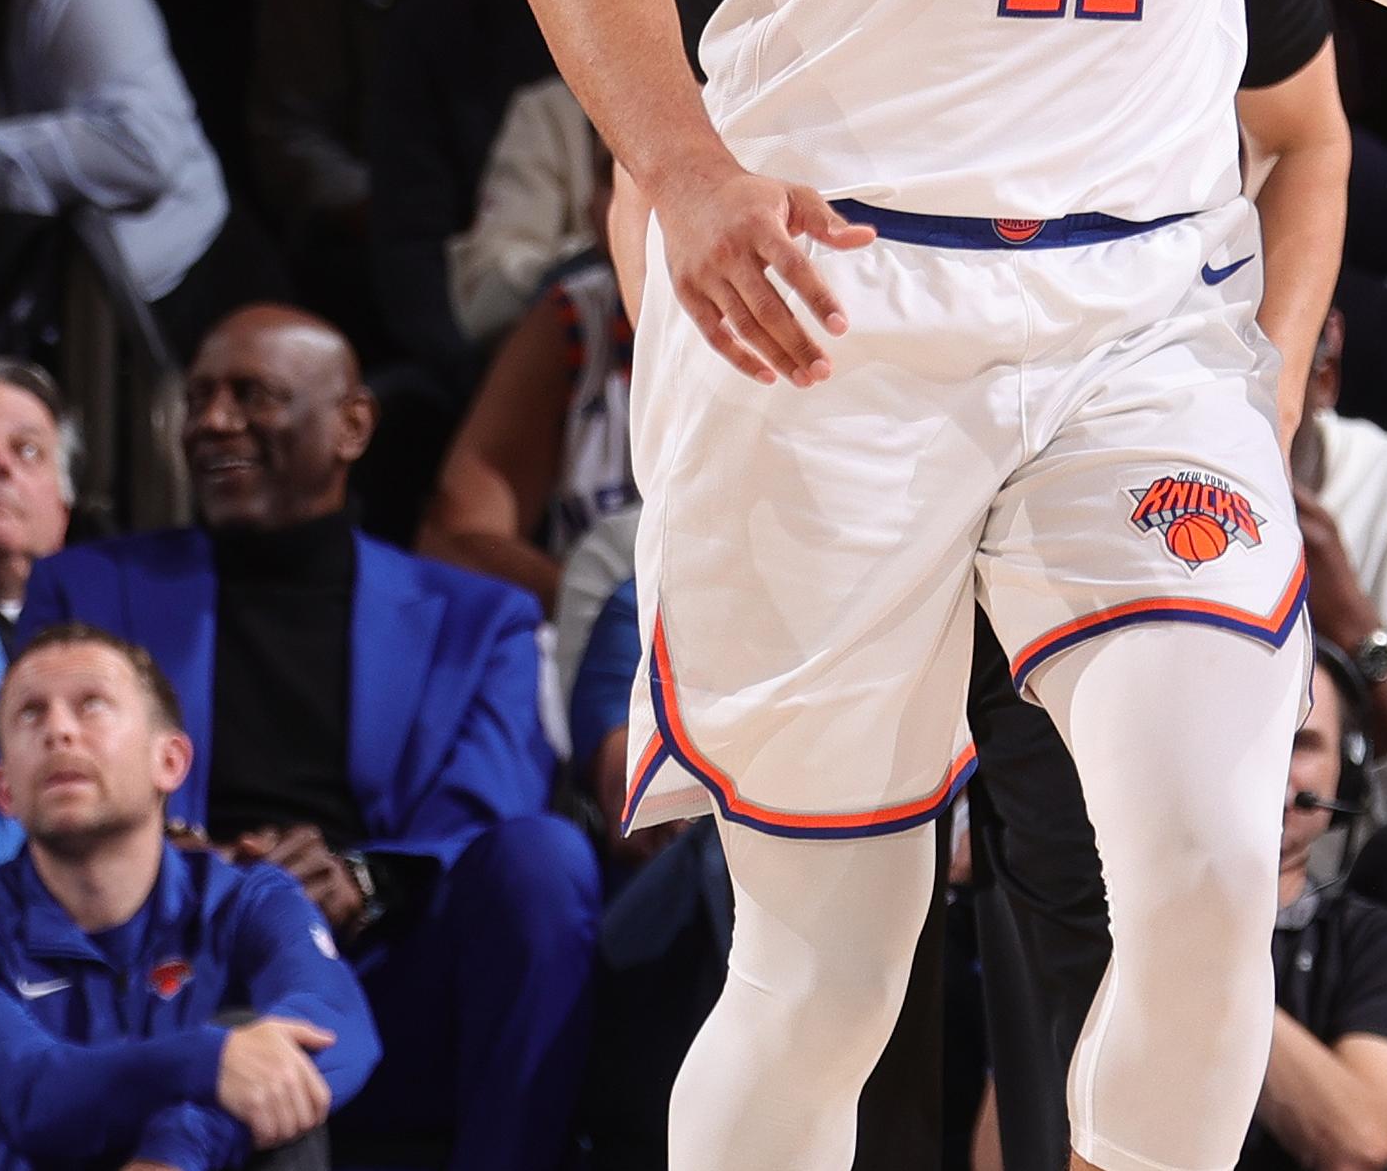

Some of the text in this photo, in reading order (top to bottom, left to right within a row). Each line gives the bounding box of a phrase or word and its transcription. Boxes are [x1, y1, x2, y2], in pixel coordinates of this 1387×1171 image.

[1177, 471, 1231, 492] NEW YORK
[1131, 476, 1262, 547] KNICKS
